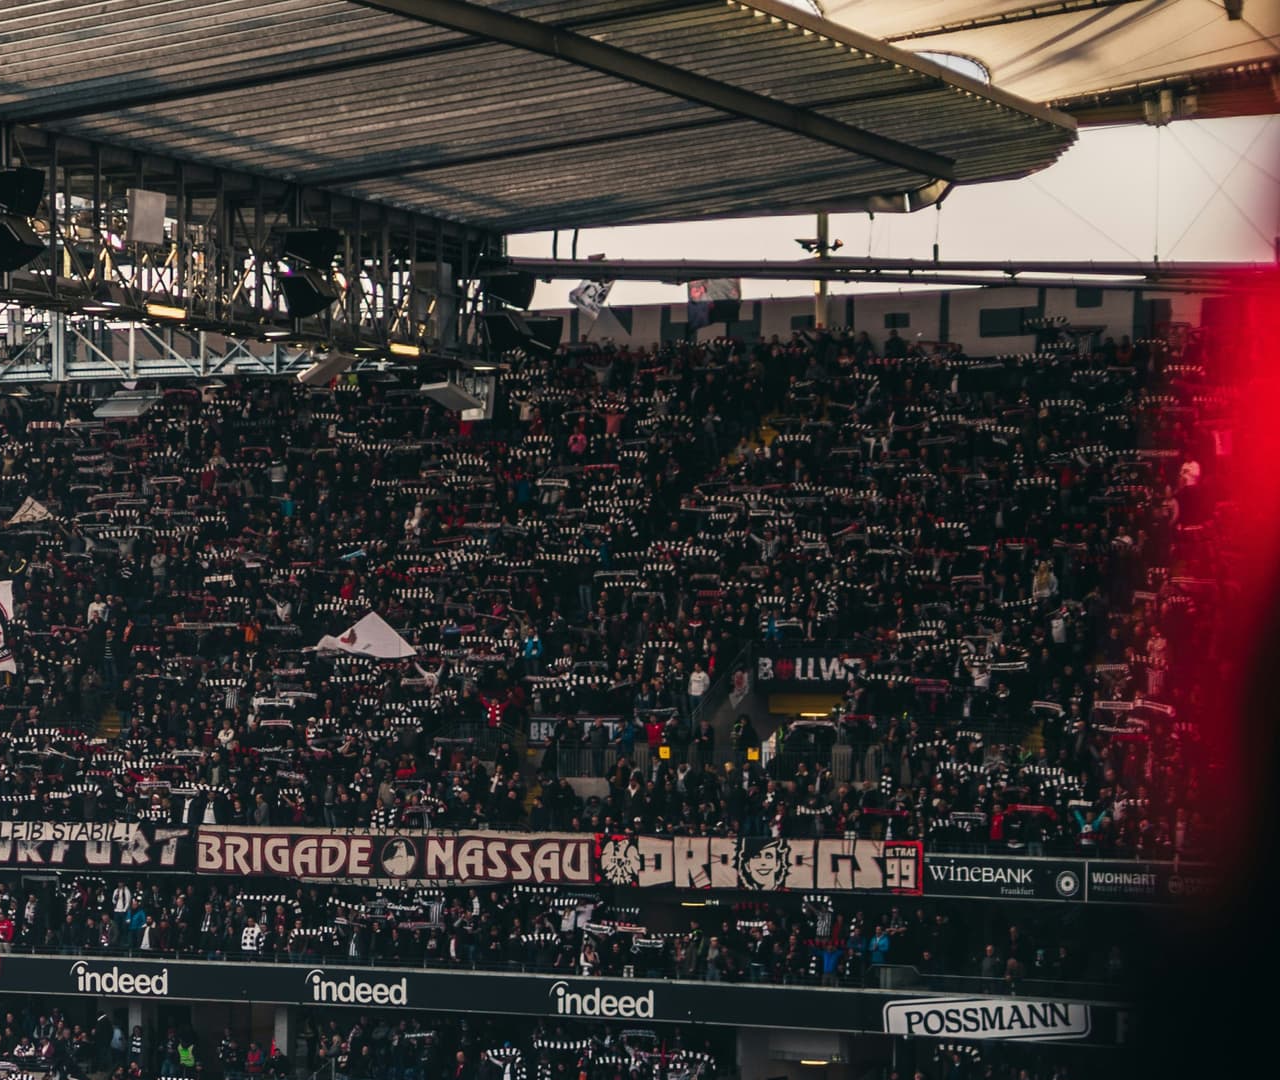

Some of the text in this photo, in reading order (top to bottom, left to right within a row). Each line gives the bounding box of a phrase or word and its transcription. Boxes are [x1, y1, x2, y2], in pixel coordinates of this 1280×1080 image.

[51, 822, 131, 843] STABIL!
[197, 834, 592, 883] BRIGADE NASSAU
[928, 858, 1034, 884] wineBANK
[1000, 886, 1035, 896] Frankfurt
[76, 966, 168, 996] indeed
[312, 975, 408, 1006] indeed
[555, 986, 655, 1019] indeed
[905, 1002, 1072, 1035] POSSMANN
